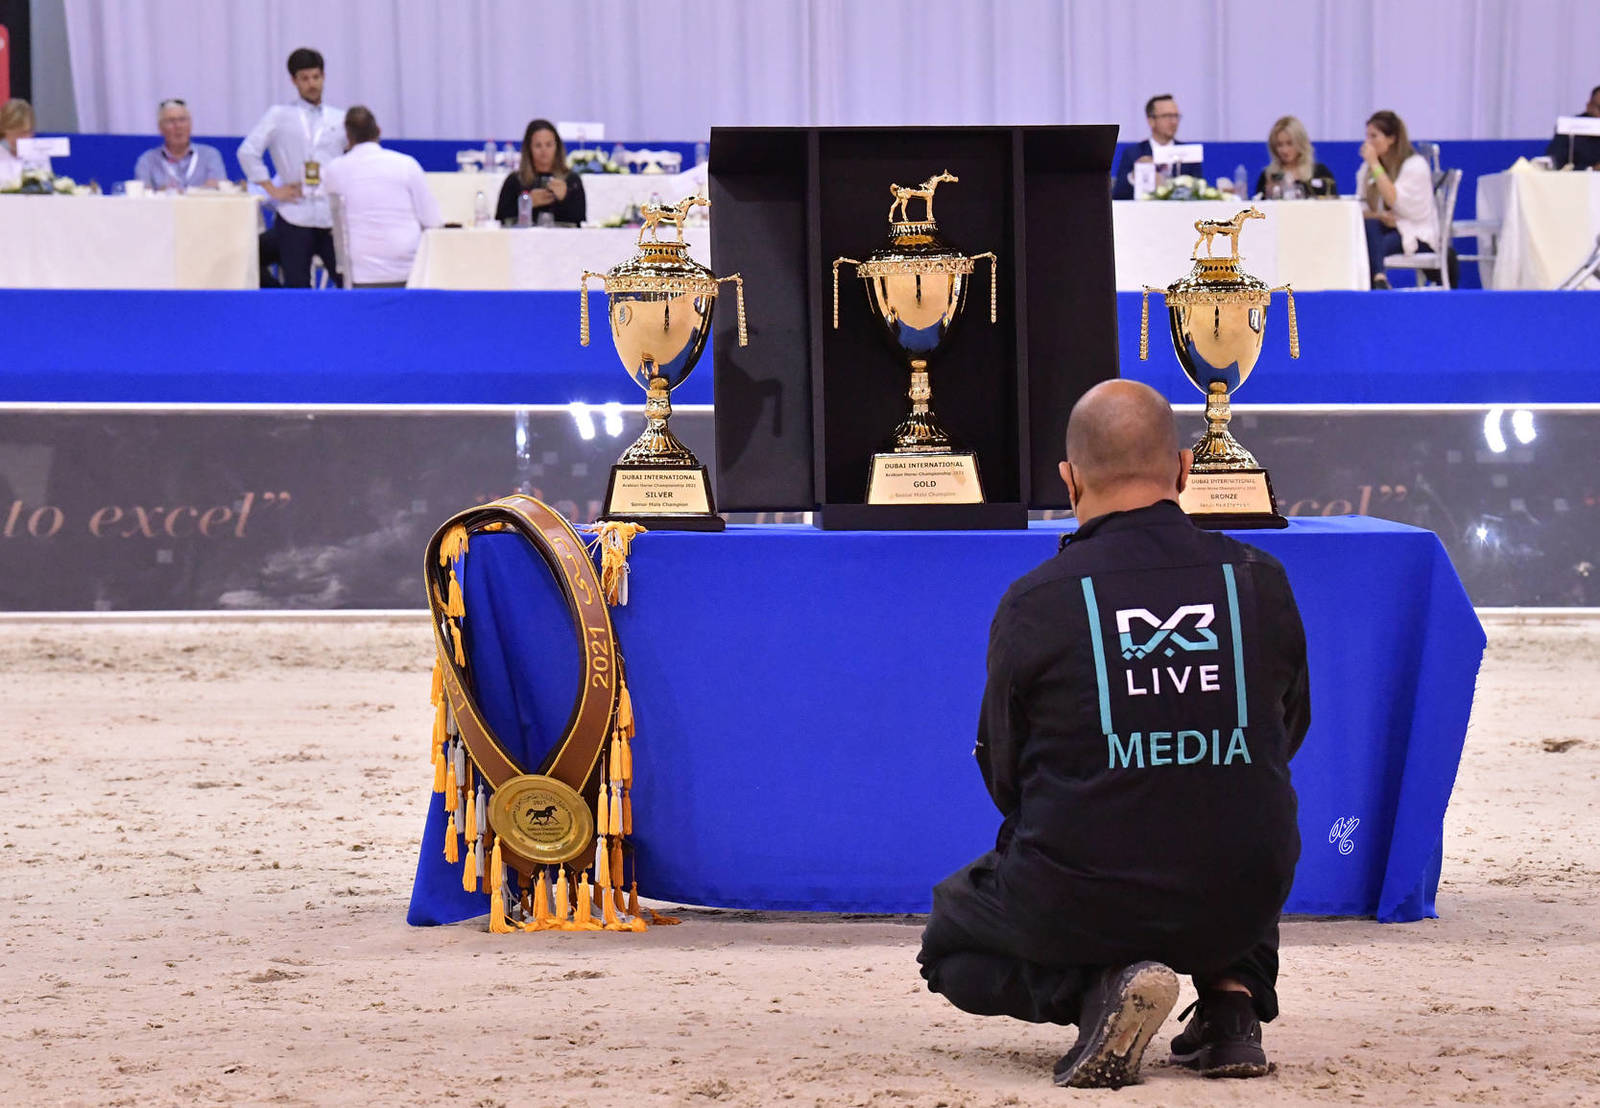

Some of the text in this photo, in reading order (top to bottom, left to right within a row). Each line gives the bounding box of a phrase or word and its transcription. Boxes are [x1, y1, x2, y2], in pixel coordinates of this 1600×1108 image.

[908, 461, 964, 469] INTERNATIONAL
[913, 480, 937, 488] GOLD
[3, 491, 291, 538] to excel”
[587, 627, 609, 689] 2021
[1126, 664, 1221, 696] LIVE
[1107, 727, 1252, 769] MEDIA
